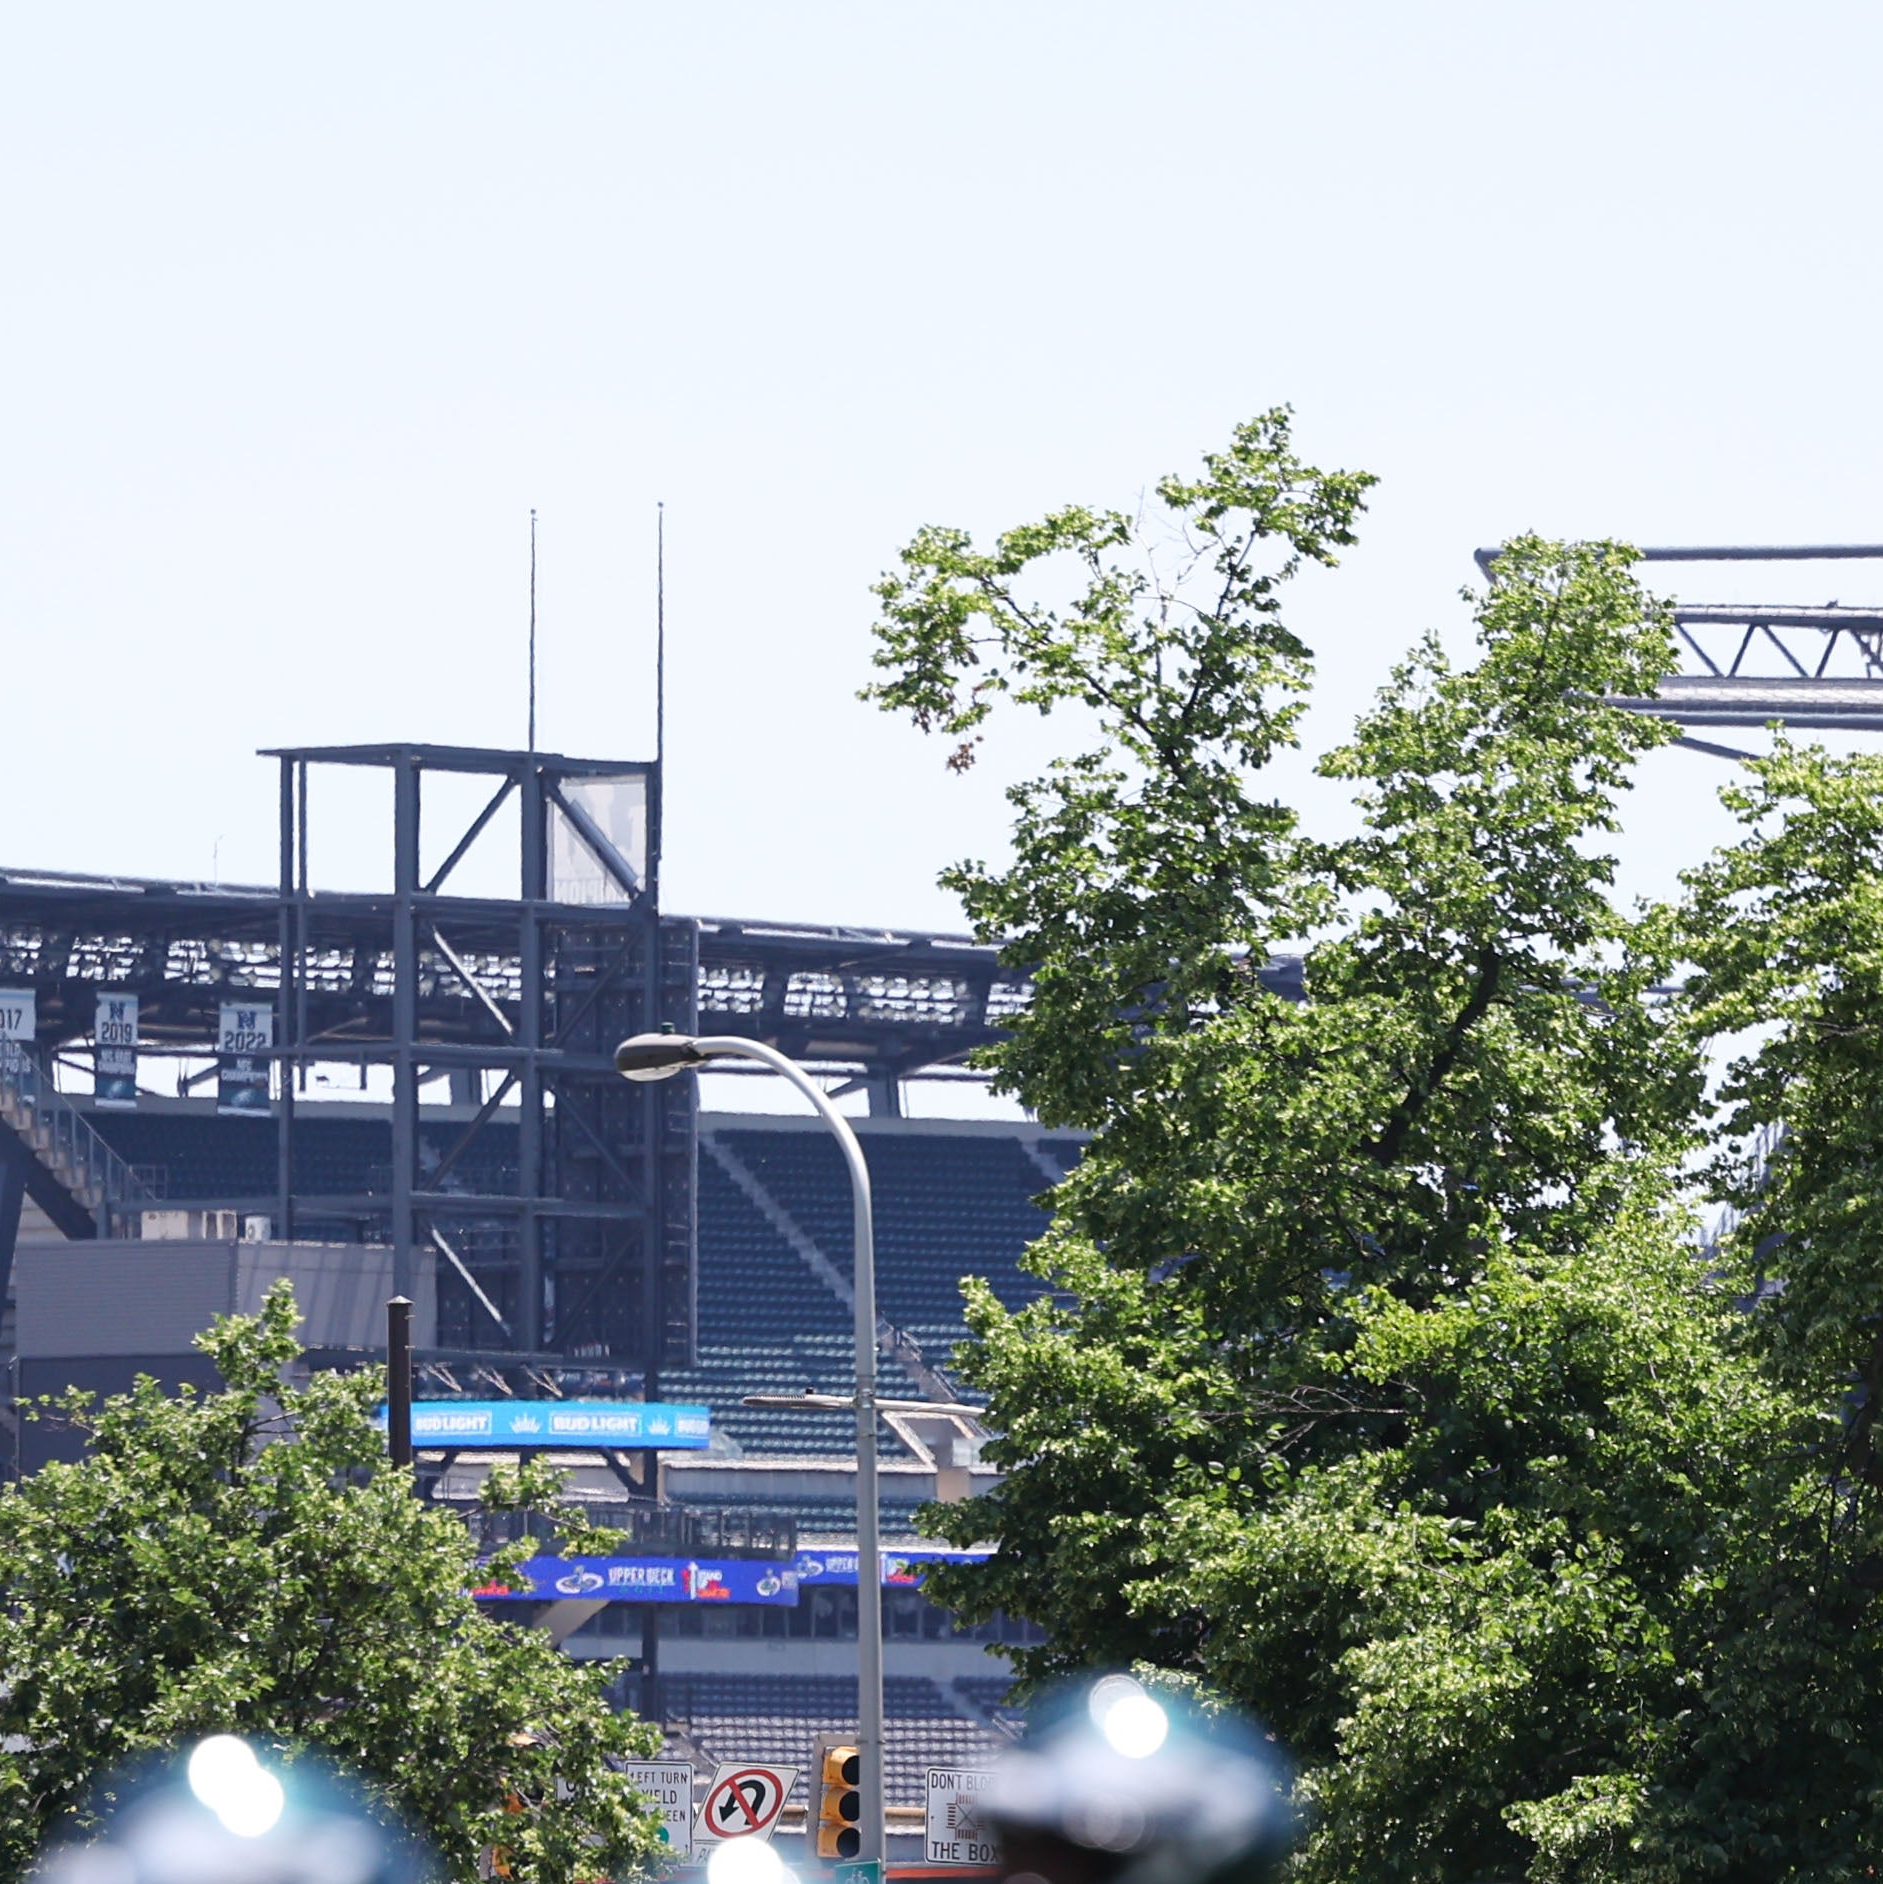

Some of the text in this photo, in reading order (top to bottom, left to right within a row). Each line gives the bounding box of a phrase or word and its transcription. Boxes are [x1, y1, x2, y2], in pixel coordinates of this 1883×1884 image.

[101, 1022, 133, 1045] 2019
[224, 1030, 267, 1050] 2022
[443, 1416, 487, 1431] LIGHT
[553, 1416, 638, 1431] BUD LIGHT
[608, 1566, 645, 1586] UPPER
[646, 1567, 675, 1586] DECK
[661, 1771, 688, 1785] TURN
[931, 1841, 999, 1863] THE BOX
